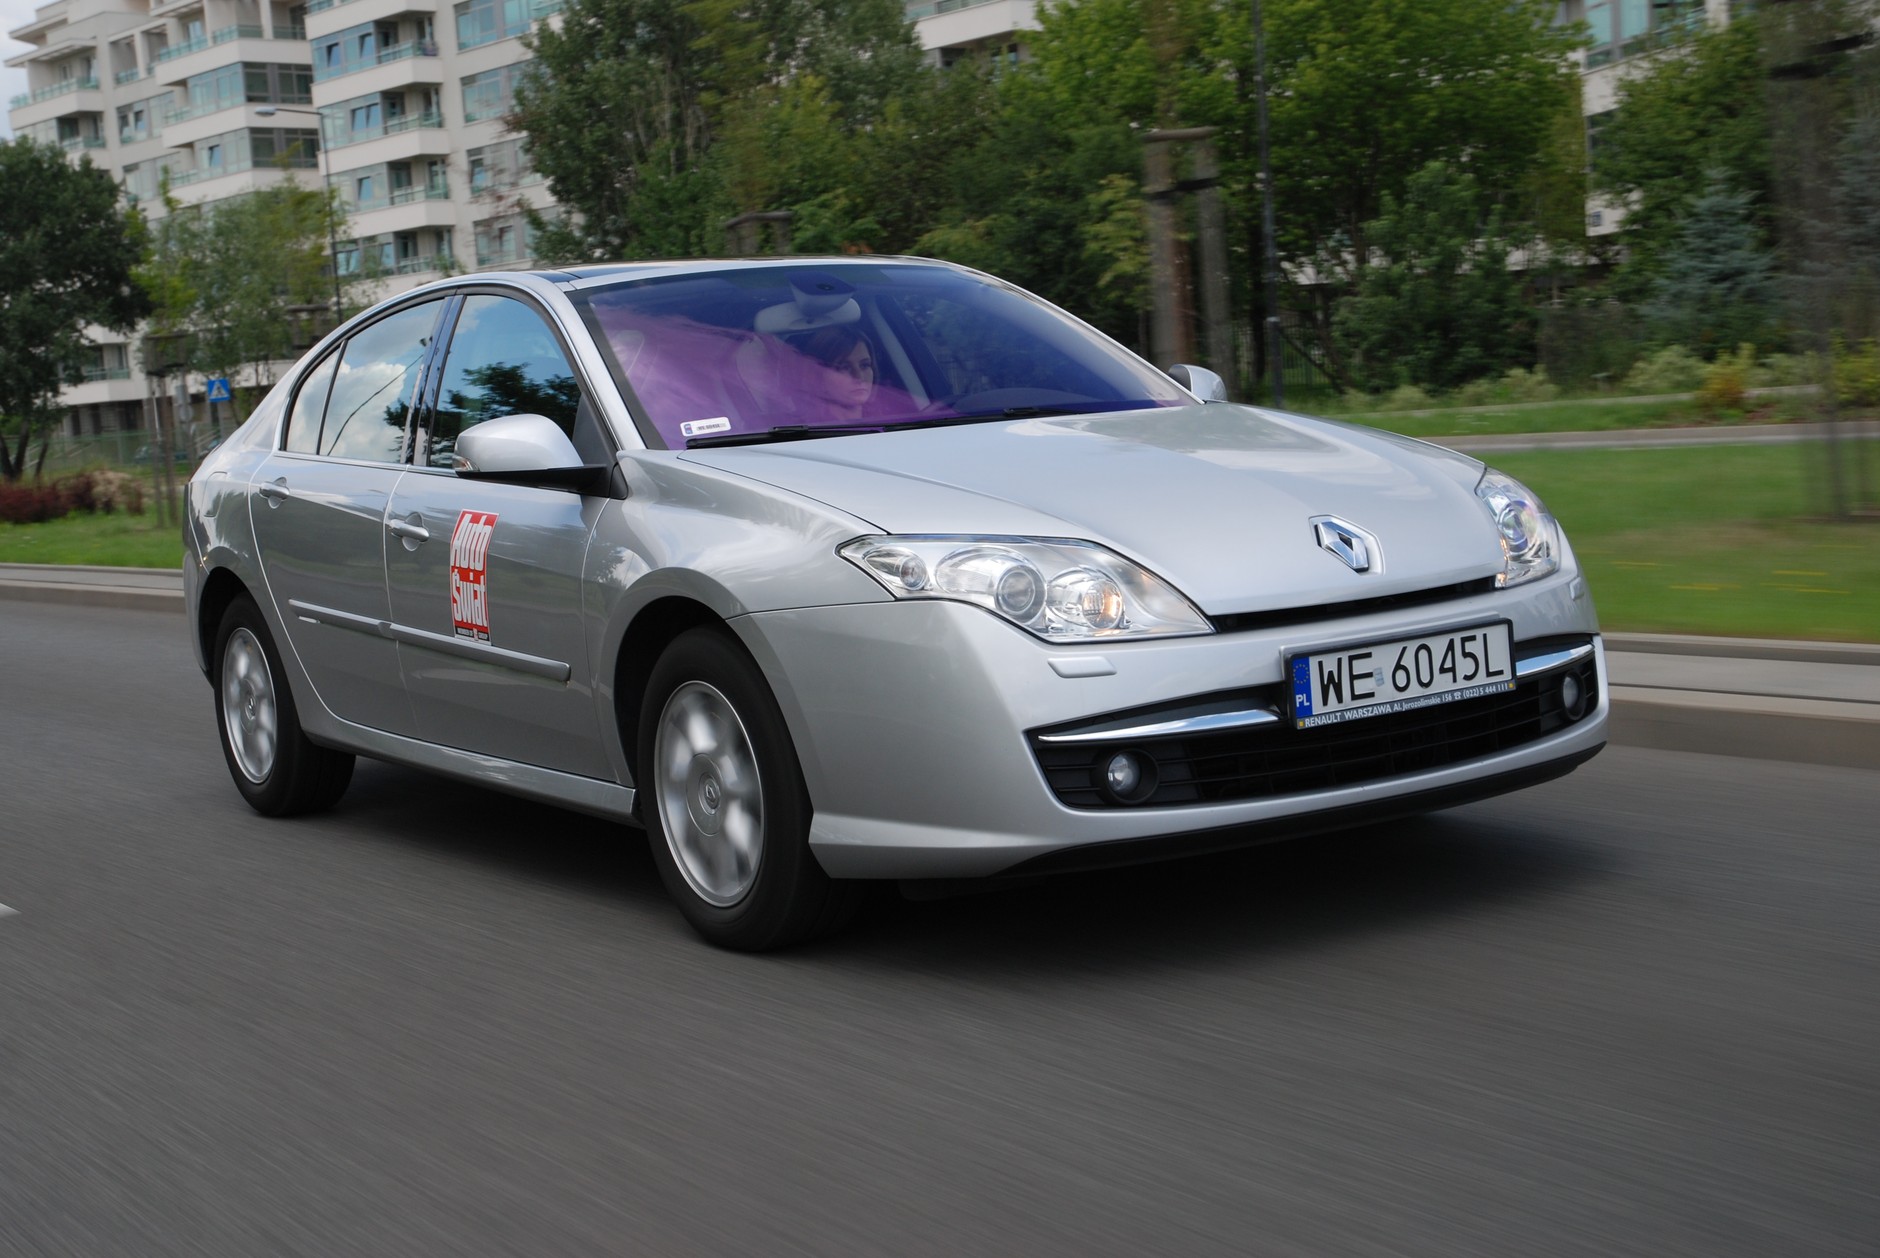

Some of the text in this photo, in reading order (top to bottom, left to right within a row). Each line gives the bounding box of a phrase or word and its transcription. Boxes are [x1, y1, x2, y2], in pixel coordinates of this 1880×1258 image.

[451, 513, 493, 571] Auto
[452, 569, 488, 627] Świat
[1318, 633, 1504, 707] WE 6045L
[1295, 693, 1310, 707] PL
[1305, 712, 1341, 728] RENAULT
[1344, 704, 1392, 720] WARSZAWA
[1442, 694, 1452, 702] 156
[1463, 688, 1479, 699] (022)
[1485, 685, 1497, 694] 444
[1497, 682, 1508, 691] 111
